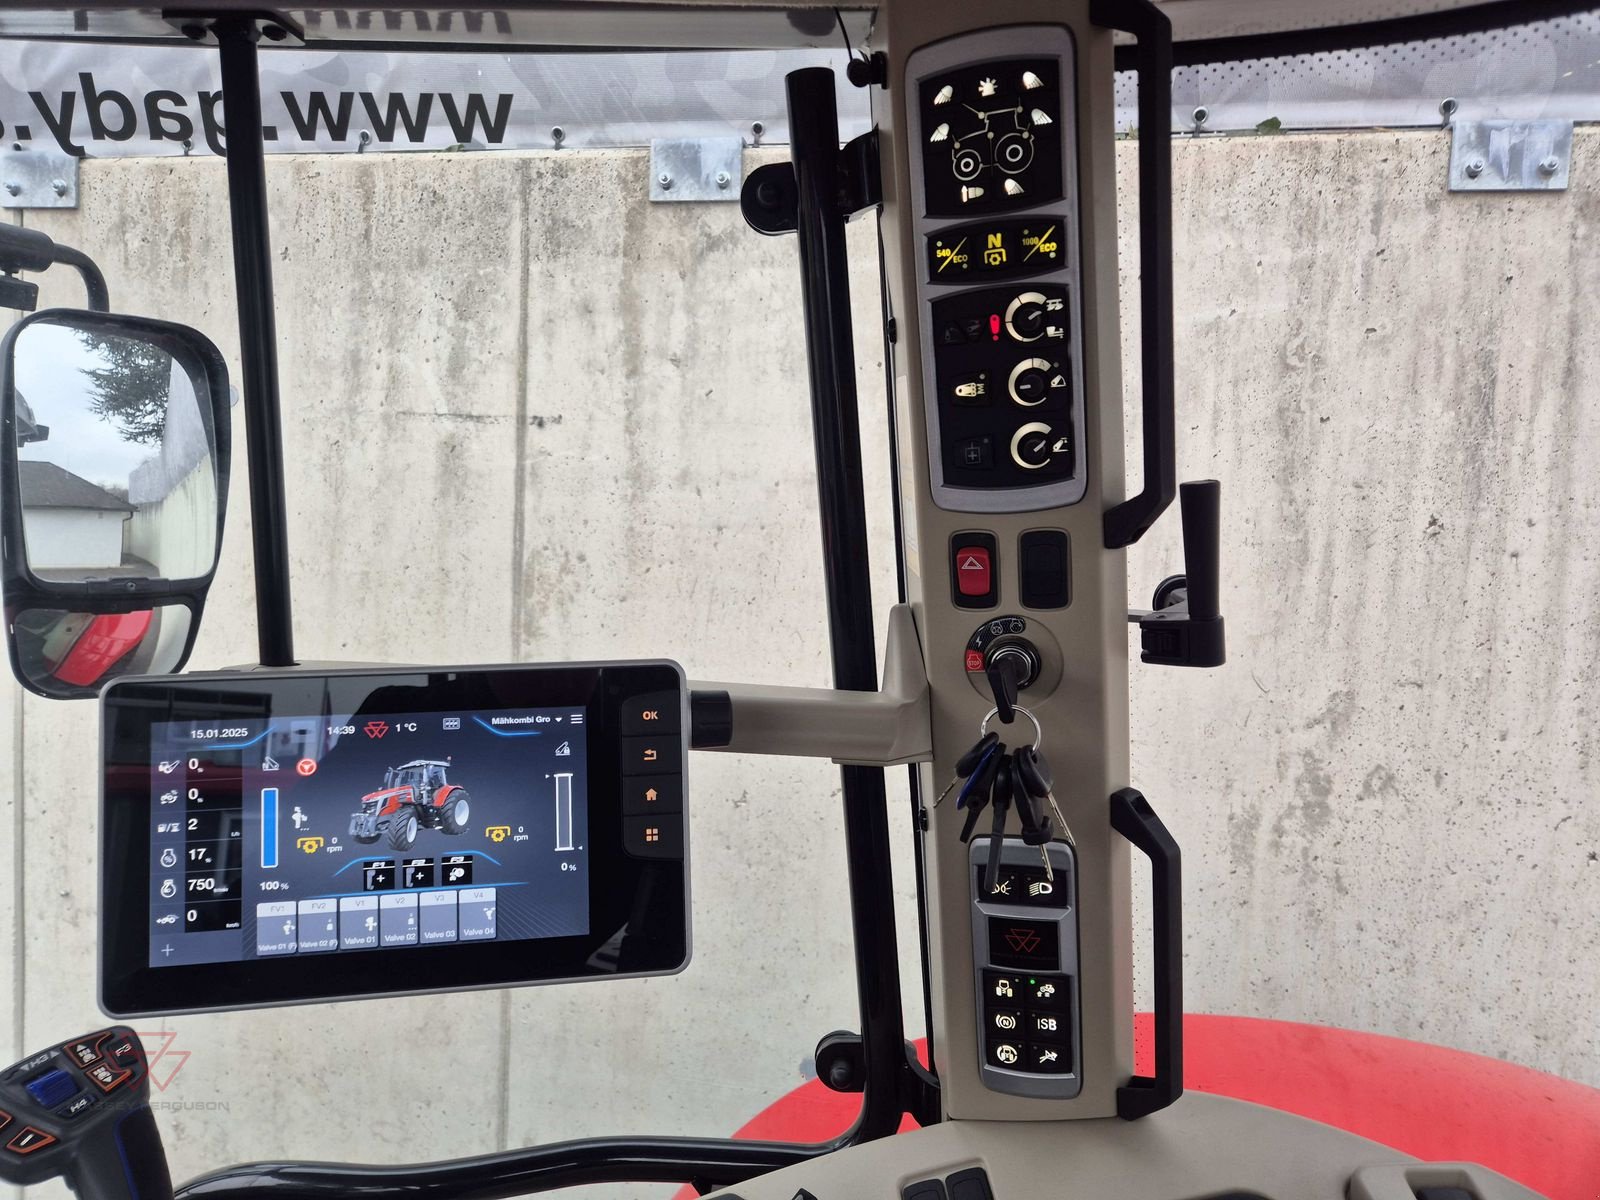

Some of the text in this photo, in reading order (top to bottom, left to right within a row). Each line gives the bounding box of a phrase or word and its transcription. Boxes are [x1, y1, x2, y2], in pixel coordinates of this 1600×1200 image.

[987, 232, 1002, 249] N
[1040, 242, 1057, 253] ECO
[936, 248, 951, 258] 540
[953, 254, 968, 264] ECO
[491, 715, 550, 725] Mähkombi Gro
[642, 711, 658, 720] OK
[327, 725, 356, 736] 14:39
[395, 722, 417, 732] 1 °C
[191, 728, 248, 739] 15.01.2025
[188, 818, 198, 830] 2
[514, 834, 528, 842] rpm
[326, 845, 343, 853] rpm
[188, 848, 207, 861] 17
[560, 862, 568, 871] 0
[187, 878, 215, 891] 750
[260, 881, 289, 891] 100 %
[311, 902, 326, 910] FV2
[187, 909, 198, 922] 0
[384, 935, 404, 943] Valve
[424, 931, 444, 939] Valve
[1037, 1018, 1057, 1031] ISB
[115, 1043, 132, 1057] F3
[69, 1098, 87, 1113] H4
